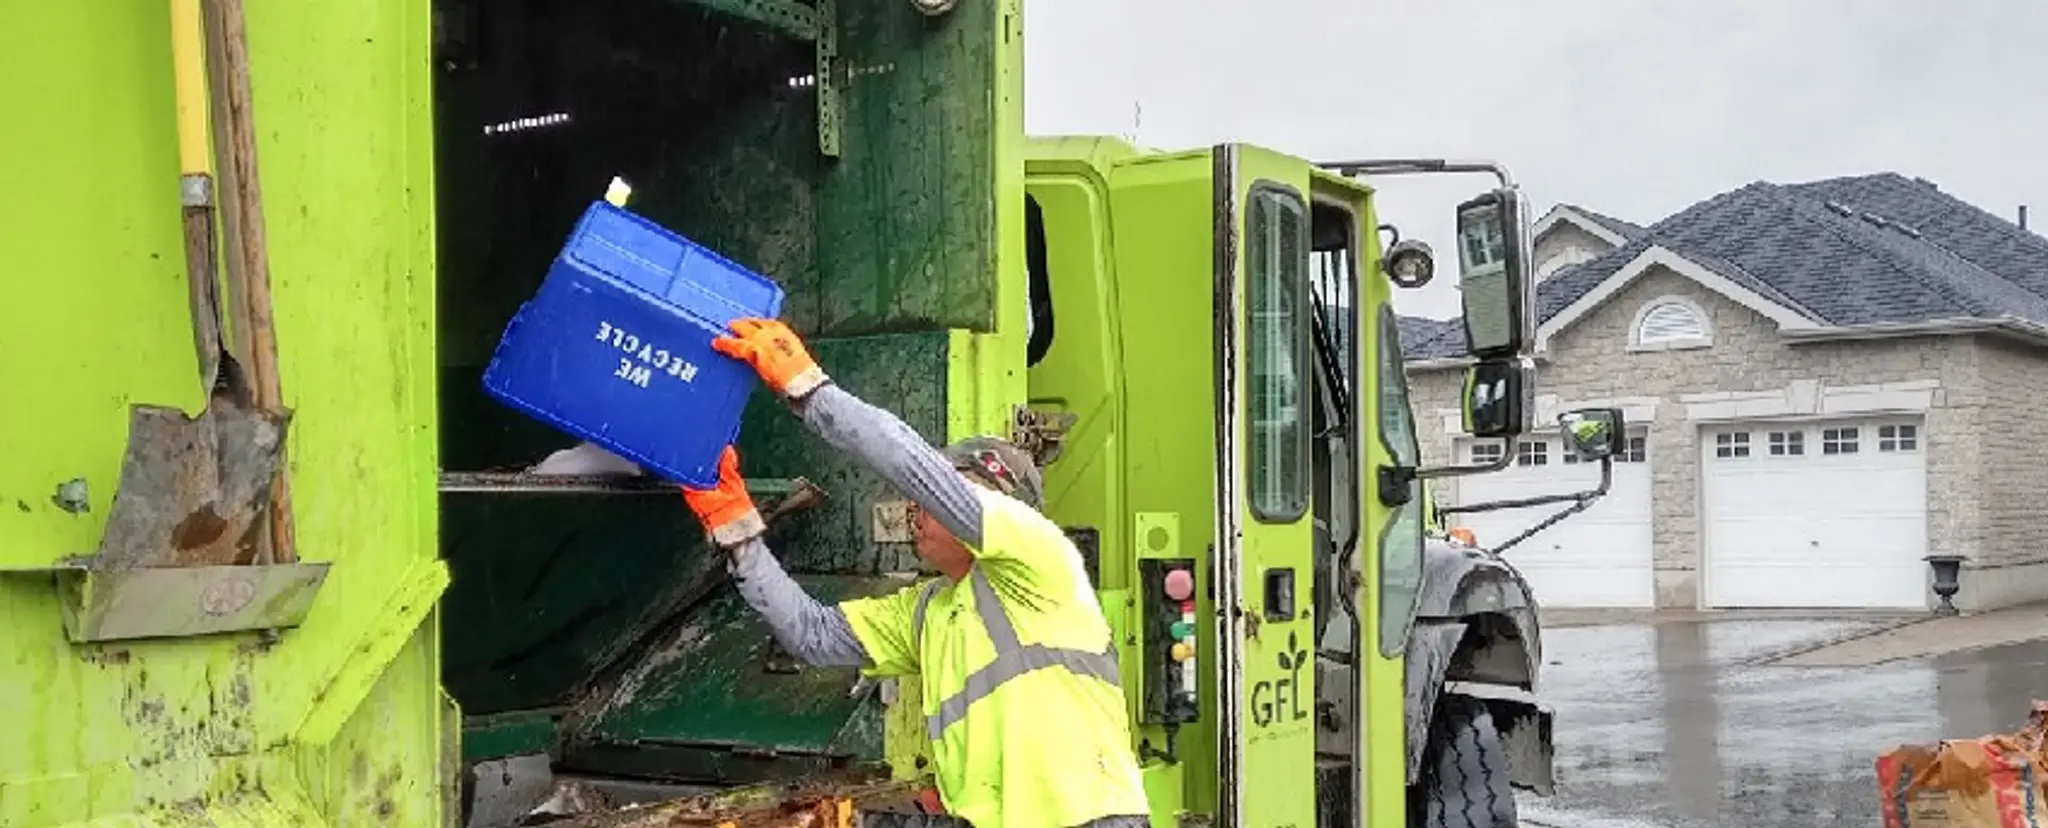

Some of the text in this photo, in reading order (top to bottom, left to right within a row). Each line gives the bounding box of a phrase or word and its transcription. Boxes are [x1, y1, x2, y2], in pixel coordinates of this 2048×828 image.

[595, 321, 699, 383] RECYCLE
[614, 357, 652, 388] WE
[1251, 663, 1308, 728] GFL
